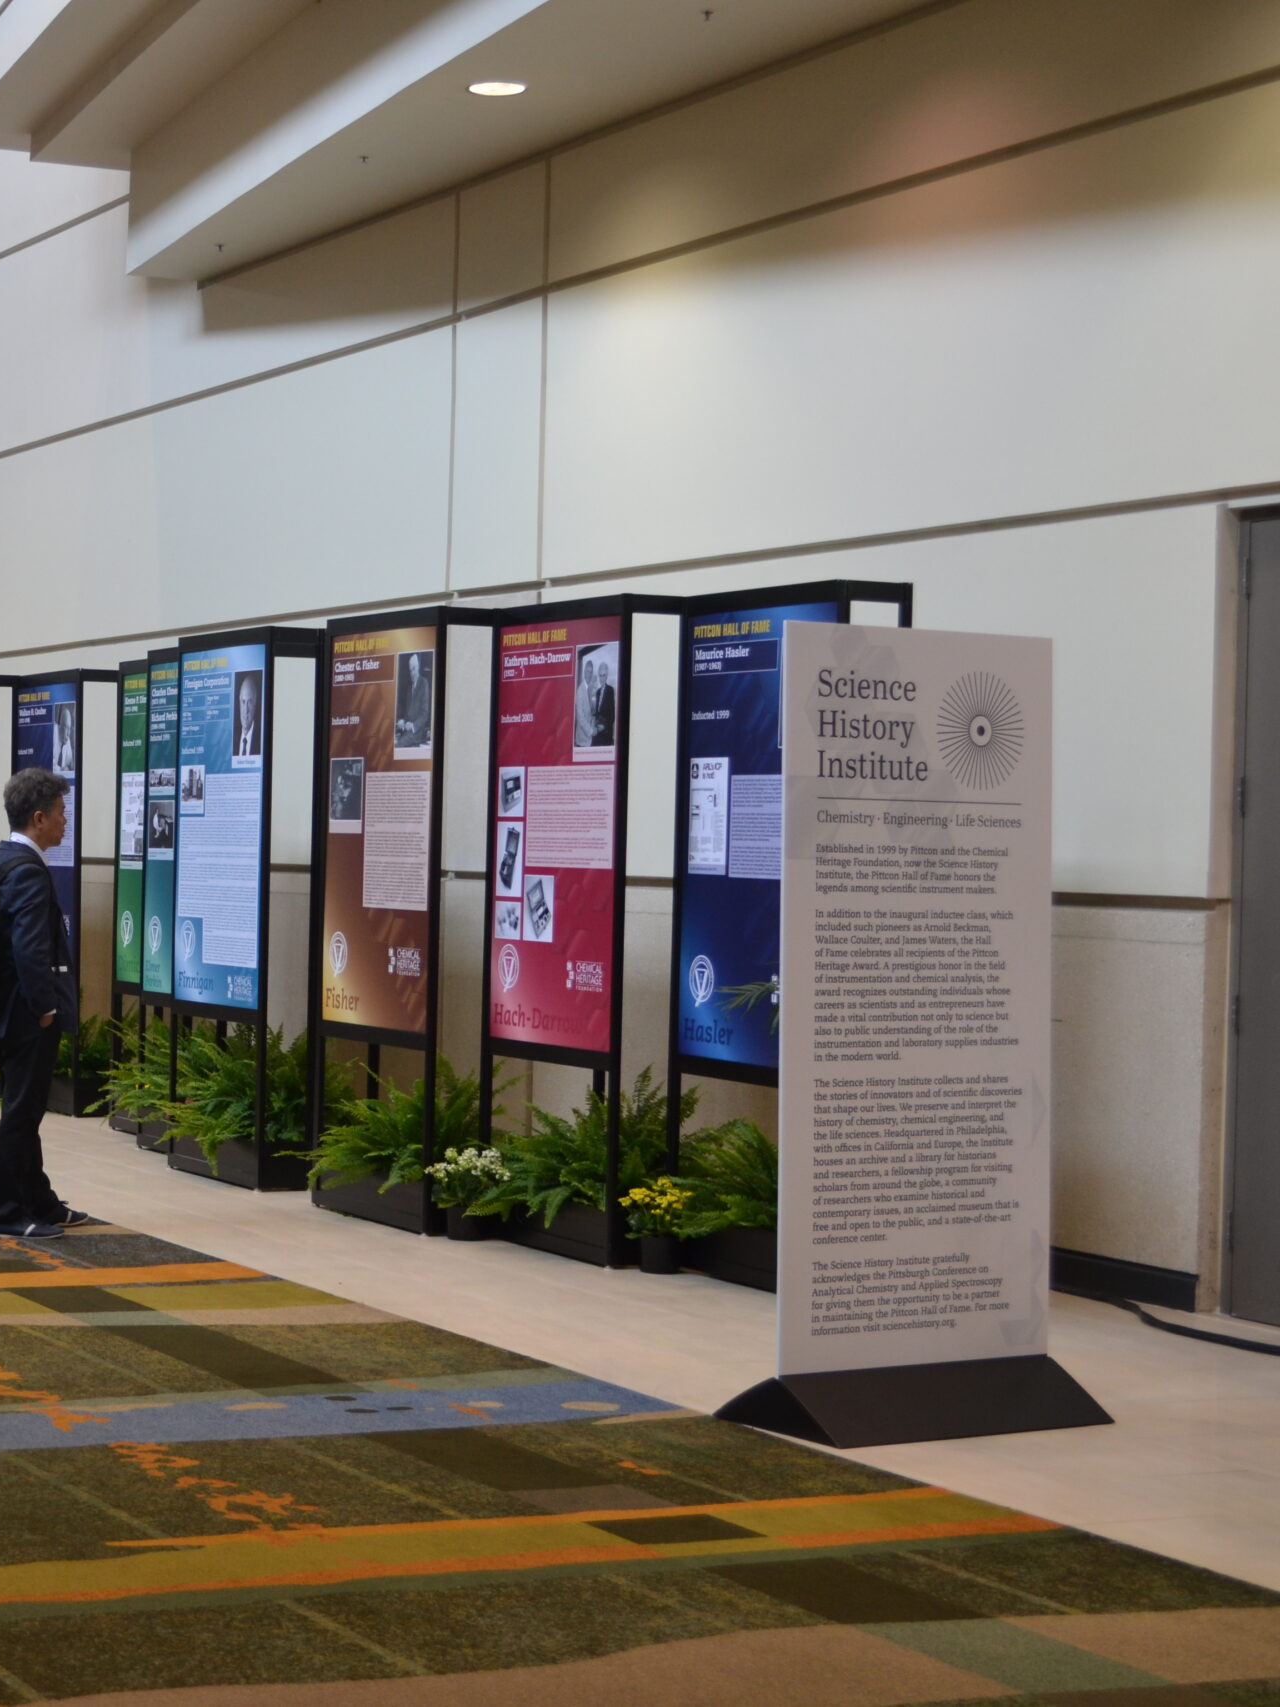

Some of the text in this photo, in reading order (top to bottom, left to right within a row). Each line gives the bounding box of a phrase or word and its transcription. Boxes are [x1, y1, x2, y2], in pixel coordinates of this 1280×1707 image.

[694, 620, 770, 639] PITTCON HALL OF FAME
[504, 652, 571, 669] Kathryn Hach-Darrow
[695, 646, 750, 660] Maurice Hasler
[335, 660, 354, 673] Chester
[363, 659, 380, 670] Fisher
[818, 669, 917, 701] Science
[691, 711, 715, 721] Inducted
[817, 710, 915, 749] History
[817, 750, 929, 781] Institute
[816, 810, 1021, 829] Chemistry Engineering Life Sciences
[815, 843, 1008, 857] Established in 1999 by Pittcon and the Chemical
[815, 856, 998, 871] Heritage Foundation, now the Science History
[815, 870, 996, 882] Institute, the Pittcon Hall of Fame honors the
[815, 883, 997, 896] legends among scientific instrument makers.
[815, 934, 991, 946] Wallace Coulter, and James Waters, the Hall
[397, 949, 420, 959] CHEMICAL
[397, 959, 420, 970] HERITAGE
[576, 962, 602, 975] CHEMICAL
[814, 960, 1006, 973] Heritage Award. A prestigious honor in the field
[576, 974, 602, 986] HERITAGE
[325, 987, 359, 1012] Fisher
[814, 985, 1011, 999] award recognizes outstanding individuals whose
[684, 1018, 734, 1045] Hasler
[814, 1035, 1019, 1050] instrumentation and laboratory supplies industries
[814, 1073, 1008, 1089] The Science History Institute collects and shares
[813, 1136, 1013, 1153] with offices in California and Europe, the Institute
[812, 1252, 969, 1271] The Science History Institute gratefully
[812, 1270, 870, 1286] acknowledges
[872, 1269, 886, 1280] the
[888, 1267, 930, 1281] Pittsburgh
[932, 1264, 976, 1277] Conference
[811, 1317, 957, 1335] information visit sciencehistory.org.
